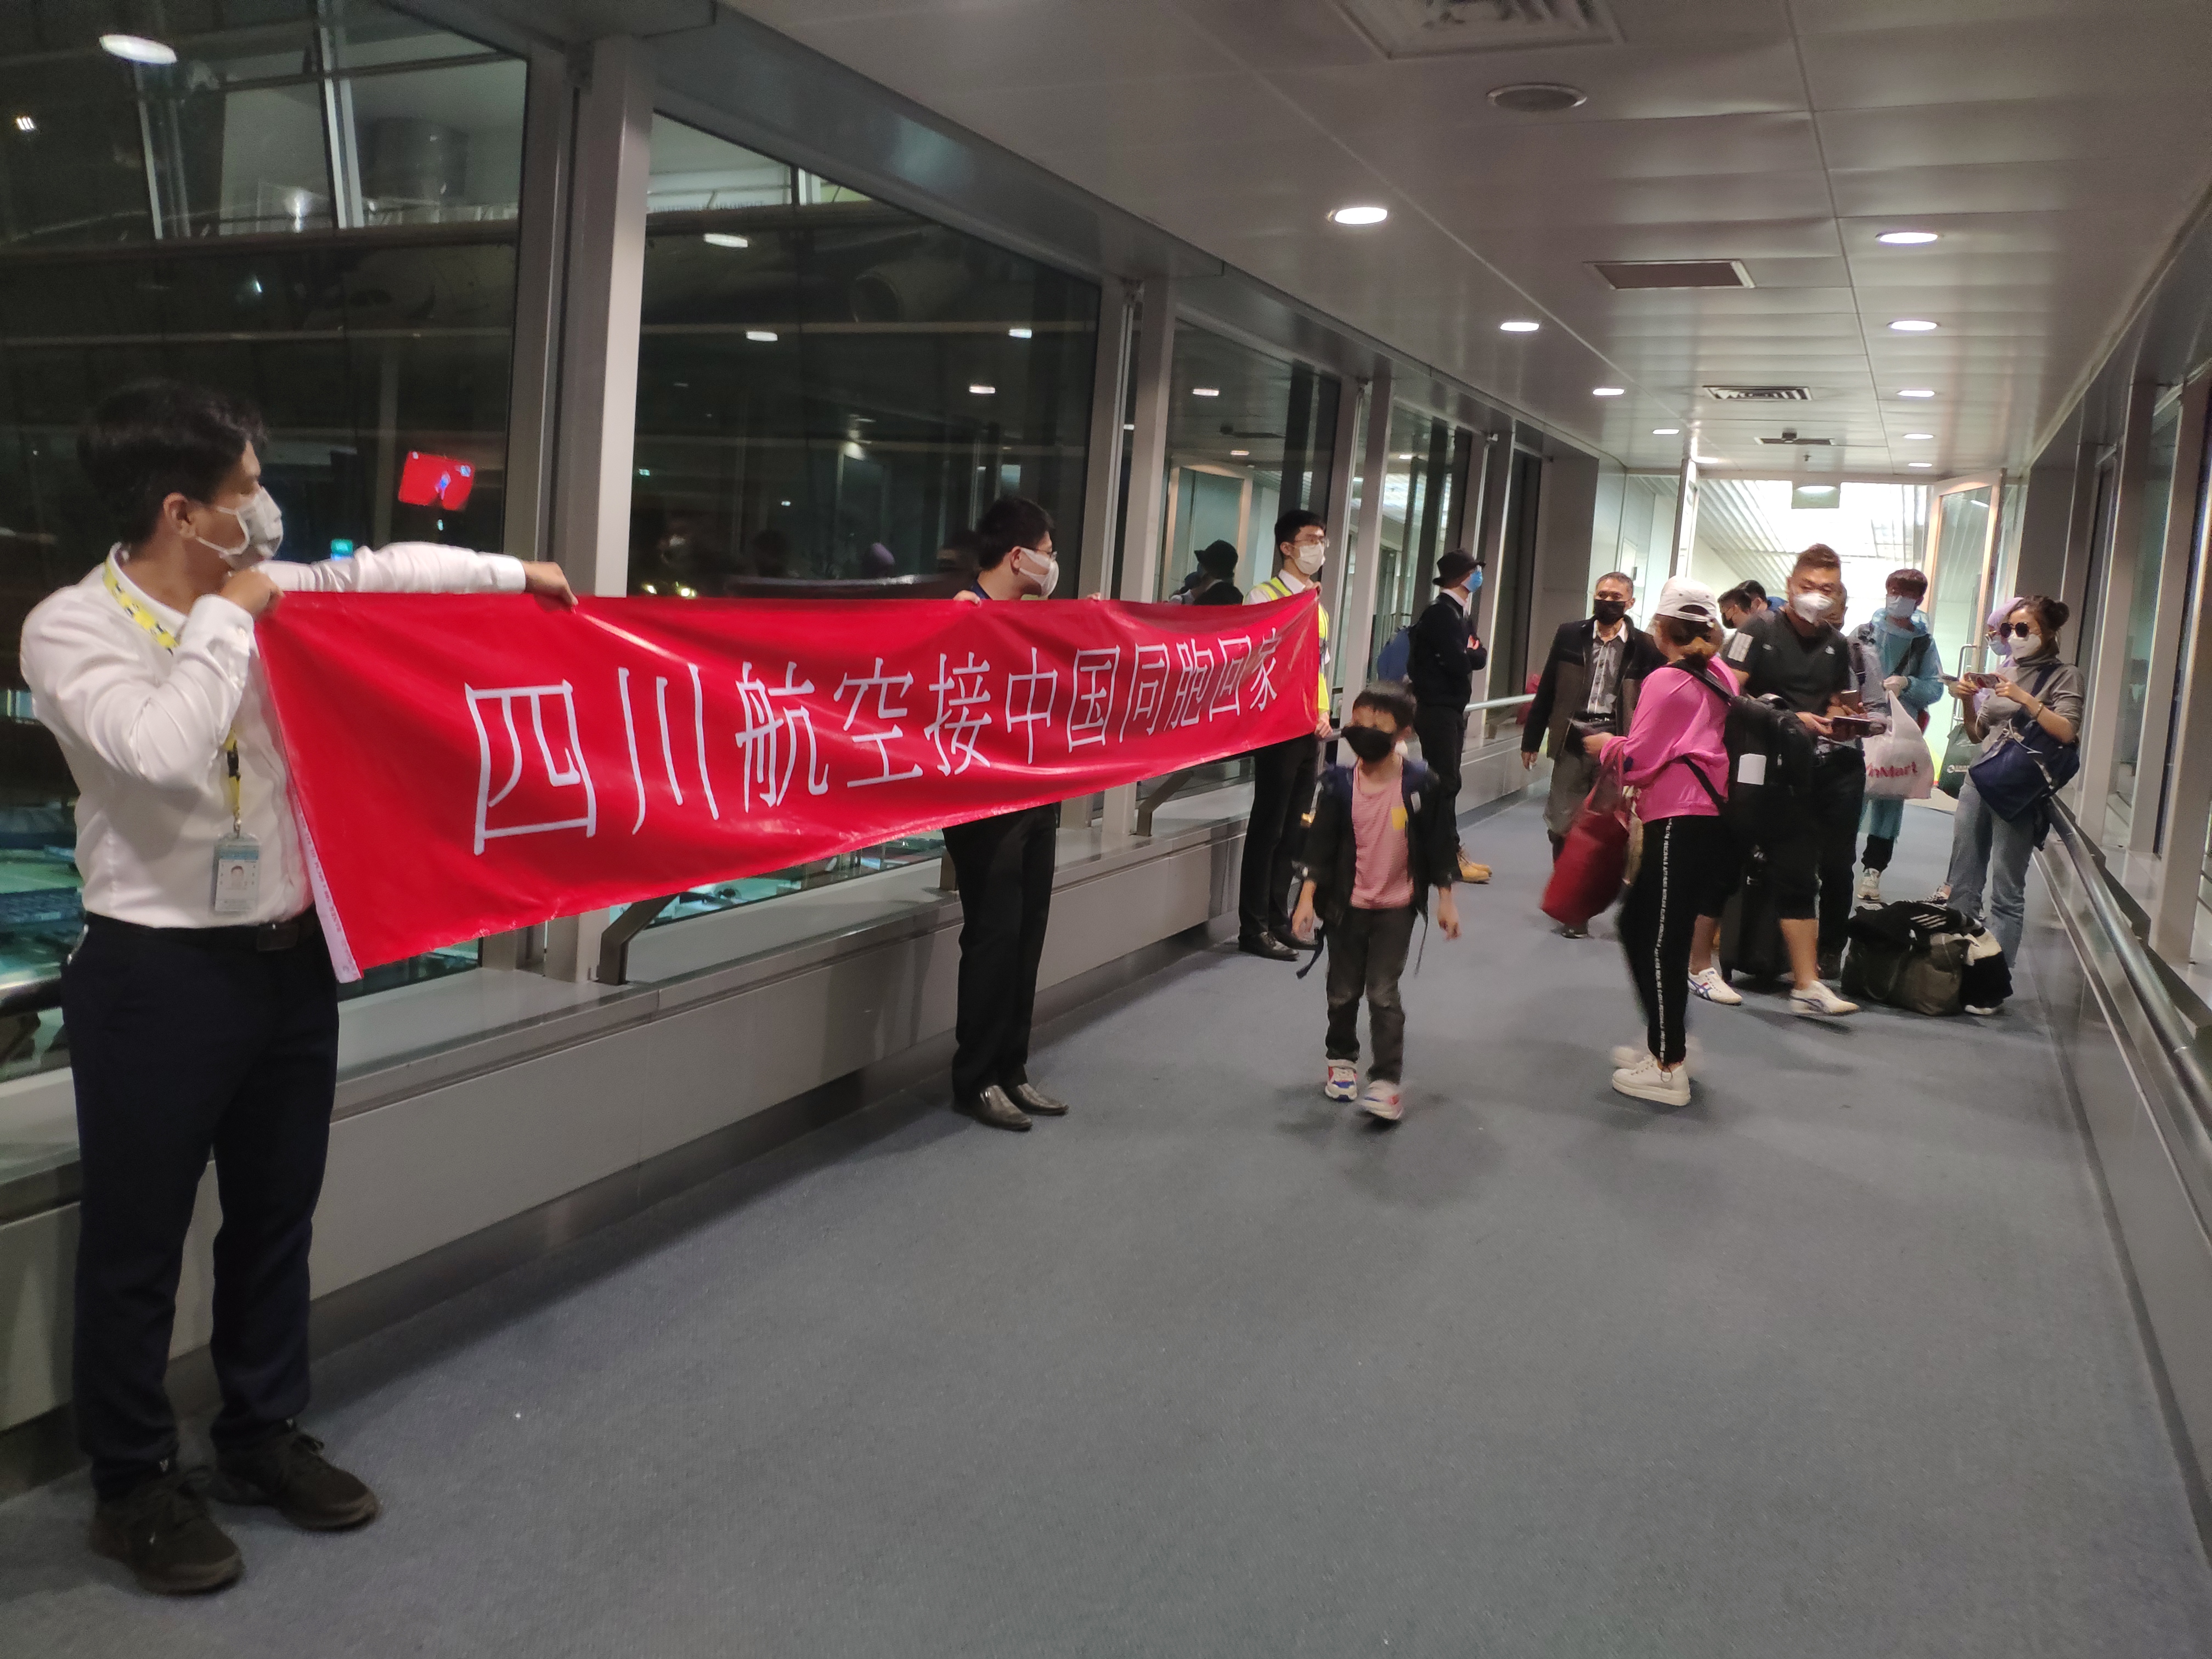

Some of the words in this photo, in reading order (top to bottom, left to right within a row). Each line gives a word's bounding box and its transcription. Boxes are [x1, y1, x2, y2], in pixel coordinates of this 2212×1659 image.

[465, 627, 1282, 855] 四川航空接中国同胞回家
